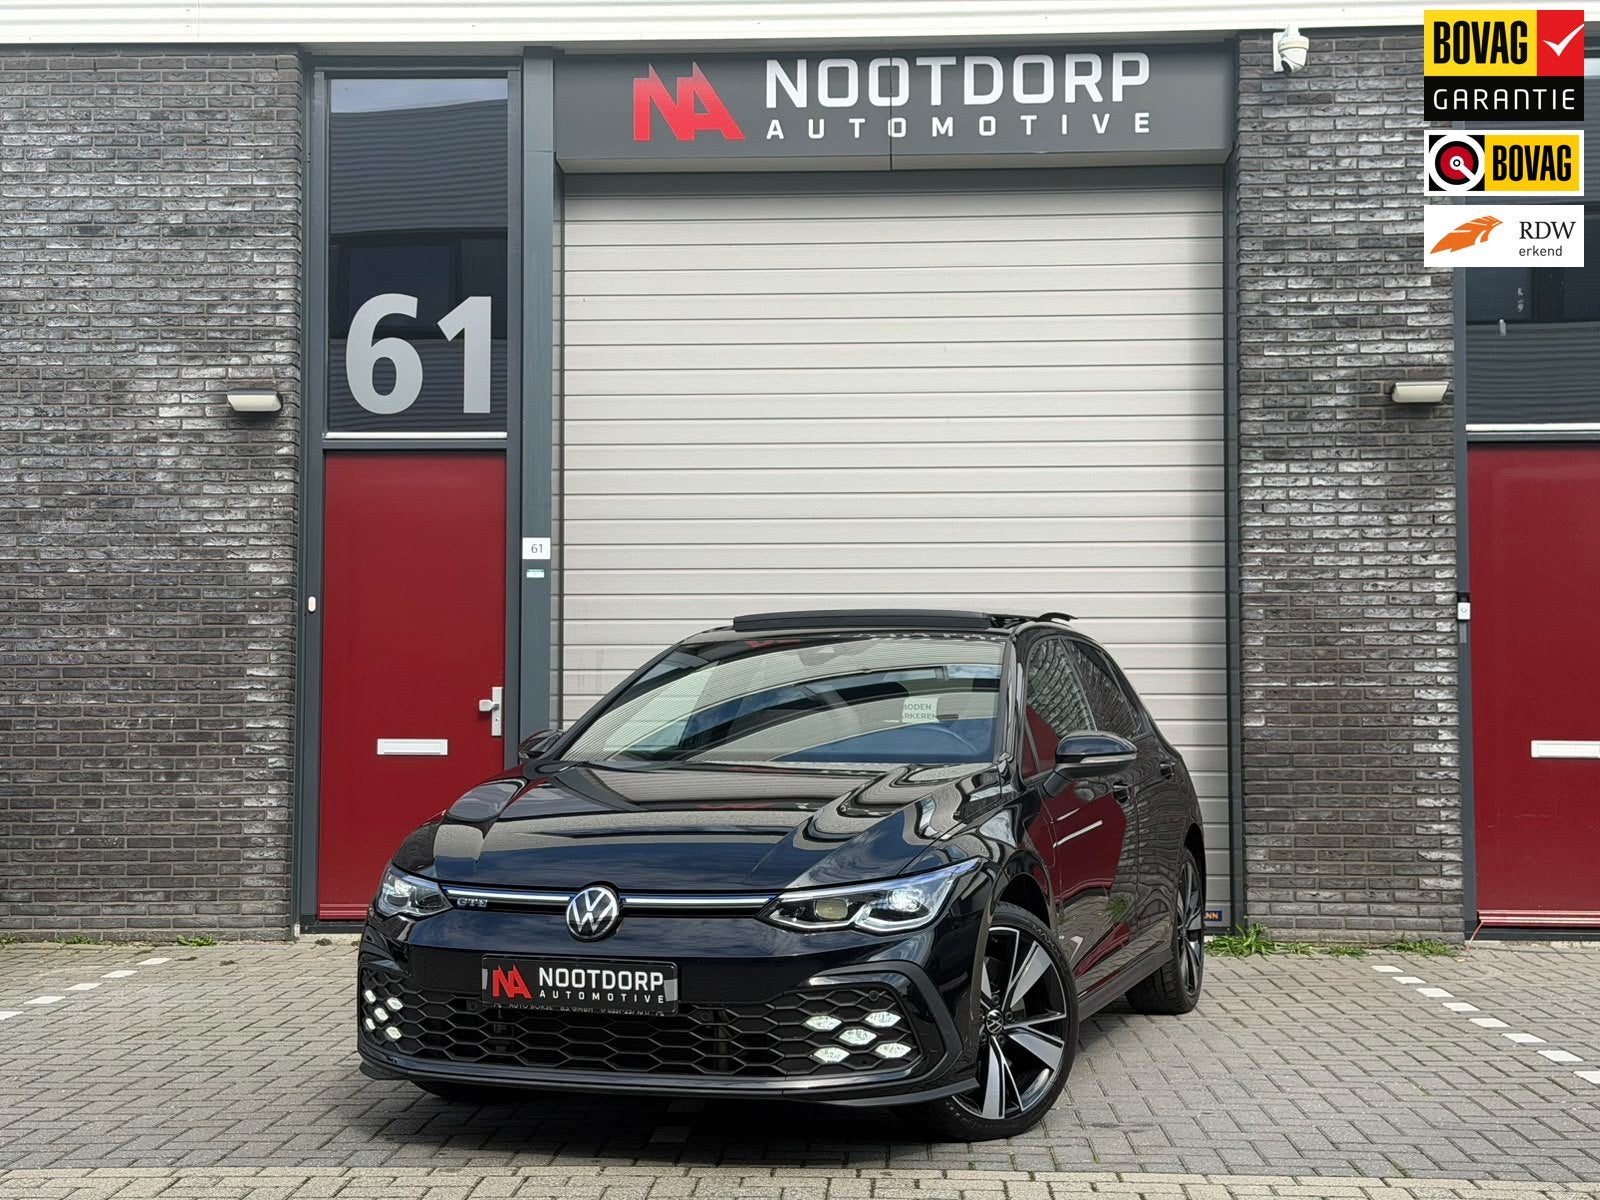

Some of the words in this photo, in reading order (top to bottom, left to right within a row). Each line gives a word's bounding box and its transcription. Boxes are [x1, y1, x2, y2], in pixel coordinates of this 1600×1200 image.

[766, 52, 1150, 109] NOOTDORP
[766, 112, 1150, 140] AUTOMOTIVE
[346, 293, 491, 414] 61
[531, 543, 543, 554] 61
[457, 898, 487, 907] GTE
[539, 967, 664, 991] NOOTDORP
[539, 989, 664, 1004] AUTOMOTIVE
